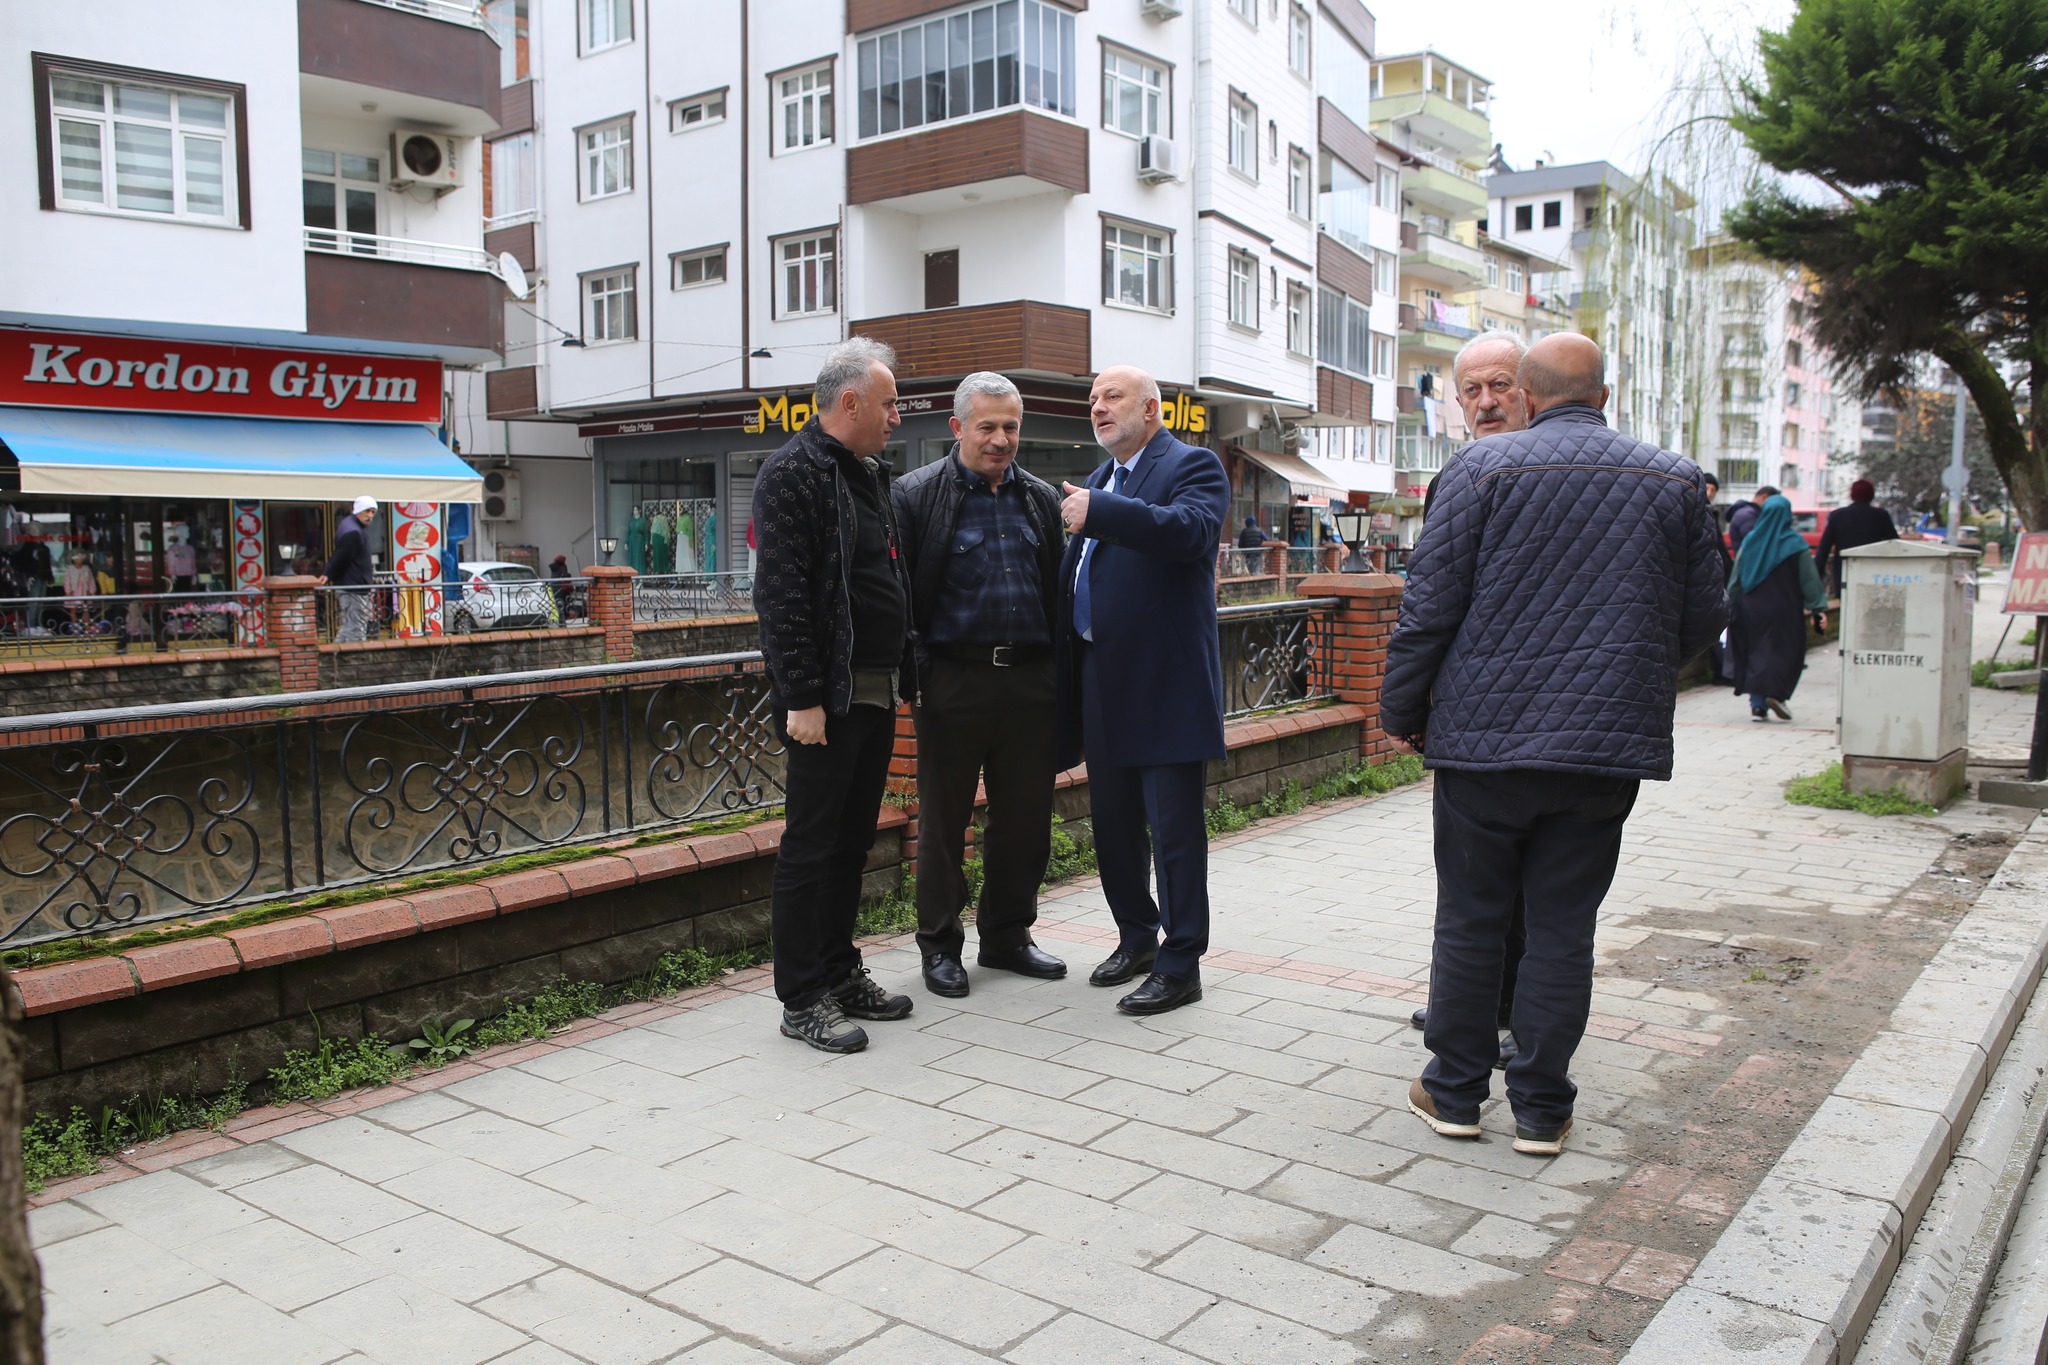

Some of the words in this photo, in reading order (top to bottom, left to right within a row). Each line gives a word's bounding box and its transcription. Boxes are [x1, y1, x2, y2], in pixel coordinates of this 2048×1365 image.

[23, 343, 250, 394] Kordon
[269, 360, 418, 410] Giyim
[1161, 392, 1206, 433] olis
[618, 424, 637, 433] Moda
[637, 422, 654, 432] Molis
[1853, 653, 1924, 667] ELEKTROTEK
